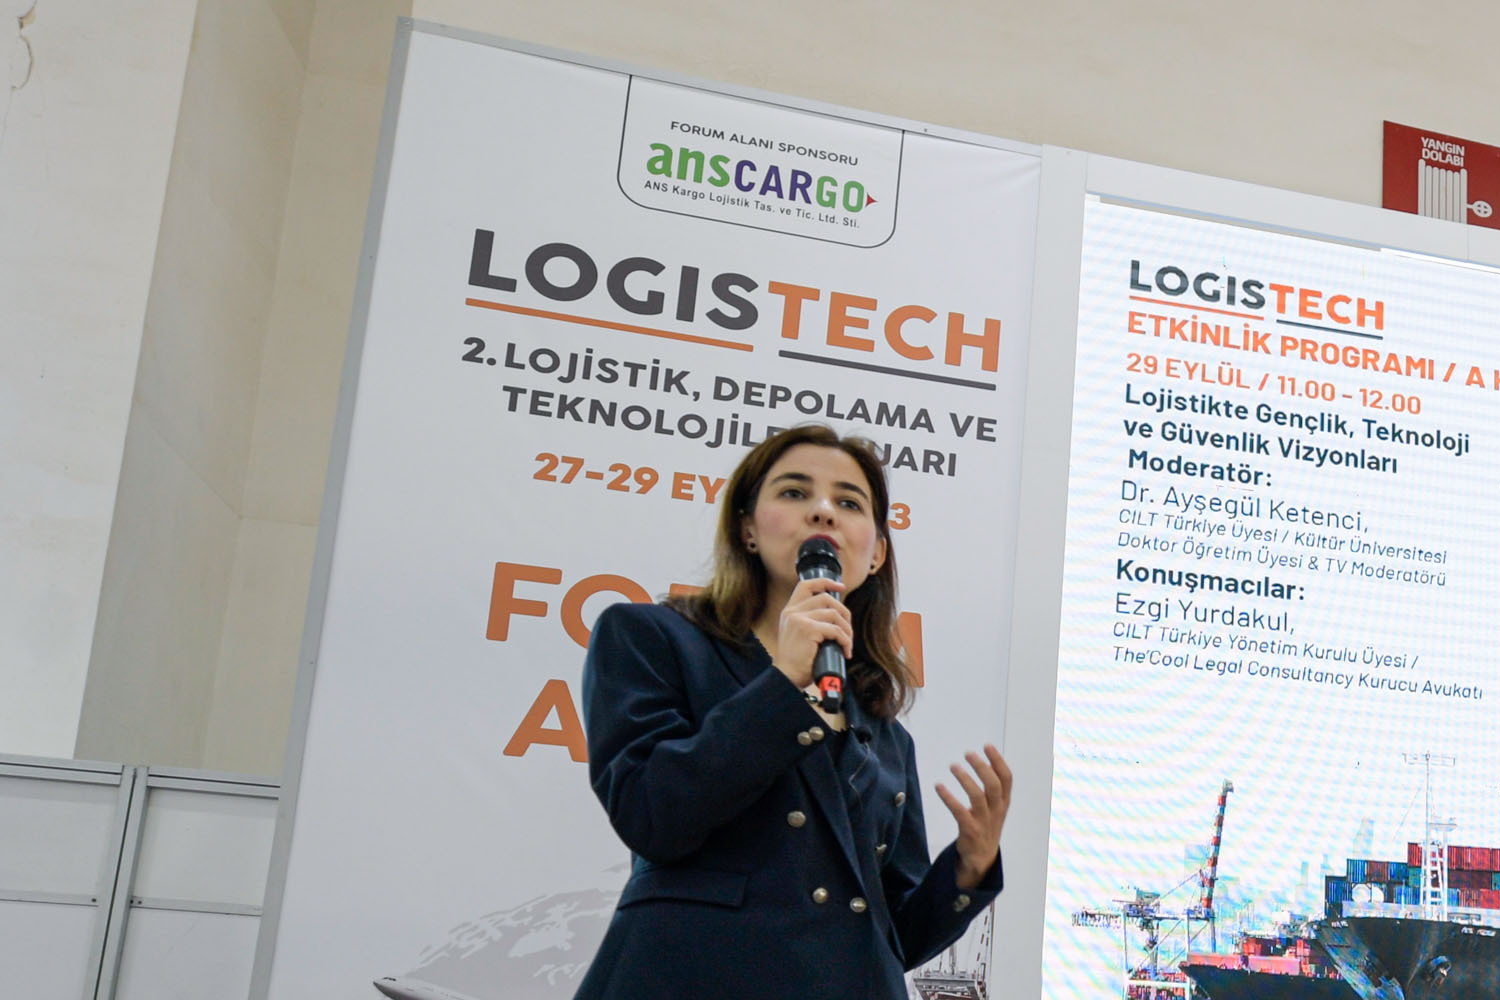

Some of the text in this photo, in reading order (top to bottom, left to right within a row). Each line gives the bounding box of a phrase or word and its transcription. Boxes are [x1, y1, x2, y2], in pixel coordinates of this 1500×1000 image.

[671, 121, 858, 166] FORUM ALANI SPONSORU
[1421, 136, 1464, 156] YANGIN
[1422, 148, 1464, 167] DOLABI
[644, 180, 668, 192] ANS
[672, 185, 705, 200] Kargo
[709, 192, 749, 208] Lojistik
[780, 207, 791, 215] ve
[796, 208, 814, 220] Tic.
[819, 213, 838, 224] Ltd.
[468, 228, 1002, 373] LOGISTECH
[1129, 260, 1384, 330] LOGISTECH
[1128, 311, 1271, 355] ETKİNLİK
[1280, 336, 1434, 382] PROGRAMI
[1466, 366, 1485, 389] A
[1126, 353, 1158, 375] 29
[1166, 358, 1249, 390] EYLÜL
[1277, 376, 1335, 402] 11.00
[1360, 389, 1421, 415] 12.00
[502, 385, 788, 450] TEKNOLOJİL
[713, 376, 934, 434] DEPOLAMA
[949, 412, 997, 443] VE
[1125, 383, 1470, 454] Lojistikte Gençlik, Teknoloji
[1124, 420, 1398, 474] ve Güvenlik Vizyonları
[1128, 449, 1272, 487] Moderatör:
[533, 452, 659, 498] 27-29
[1121, 480, 1369, 534] Dr. Ayşegül Ketenci,
[1118, 532, 1177, 553] Doktor
[1182, 536, 1252, 562] Öğretim
[1257, 546, 1303, 569] Üyesi
[1324, 558, 1346, 573] TV
[1352, 562, 1446, 587] Moderatörü
[1164, 514, 1226, 537] Türkiye
[1231, 520, 1277, 543] Üyesi
[1295, 532, 1346, 550] Kültür
[1350, 537, 1447, 564] Üniversitesi
[1116, 558, 1306, 600] Konuşmacılar:
[1115, 592, 1295, 635] Ezgi Yurdakul,
[1160, 625, 1222, 650] Türkiye
[1228, 634, 1298, 657] Yönetim
[1302, 643, 1356, 664] Kurulu
[1362, 646, 1407, 671] Üyesi
[1193, 657, 1242, 677] Legal
[1247, 660, 1353, 690] Consultancy
[1359, 673, 1417, 694] Kurucu
[1421, 681, 1483, 700] Avukatı
